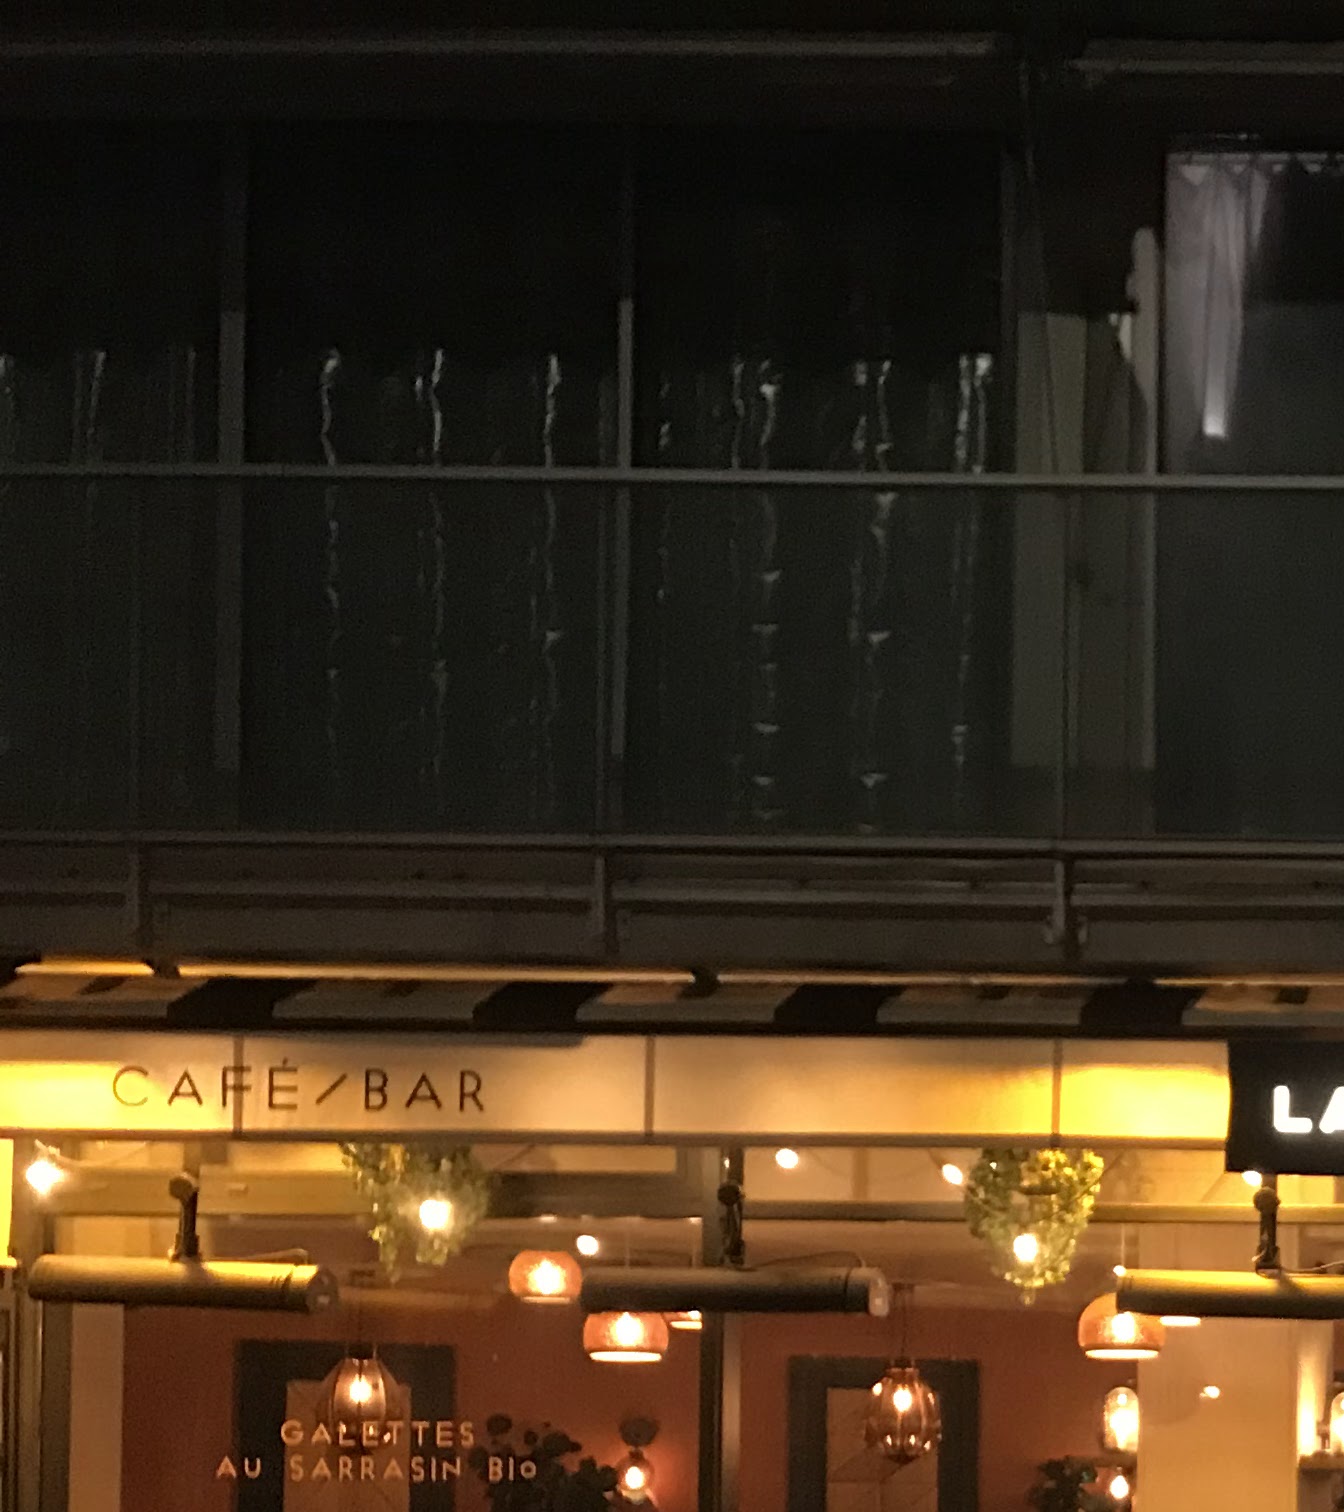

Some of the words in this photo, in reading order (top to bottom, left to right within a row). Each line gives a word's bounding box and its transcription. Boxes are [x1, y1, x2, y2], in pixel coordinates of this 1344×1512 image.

[112, 1057, 485, 1112] CAFÉ/BAR
[280, 1420, 475, 1447] GALETTES
[215, 1455, 262, 1480] AU
[289, 1456, 462, 1482] SARRASIN
[488, 1456, 537, 1482] BIO
